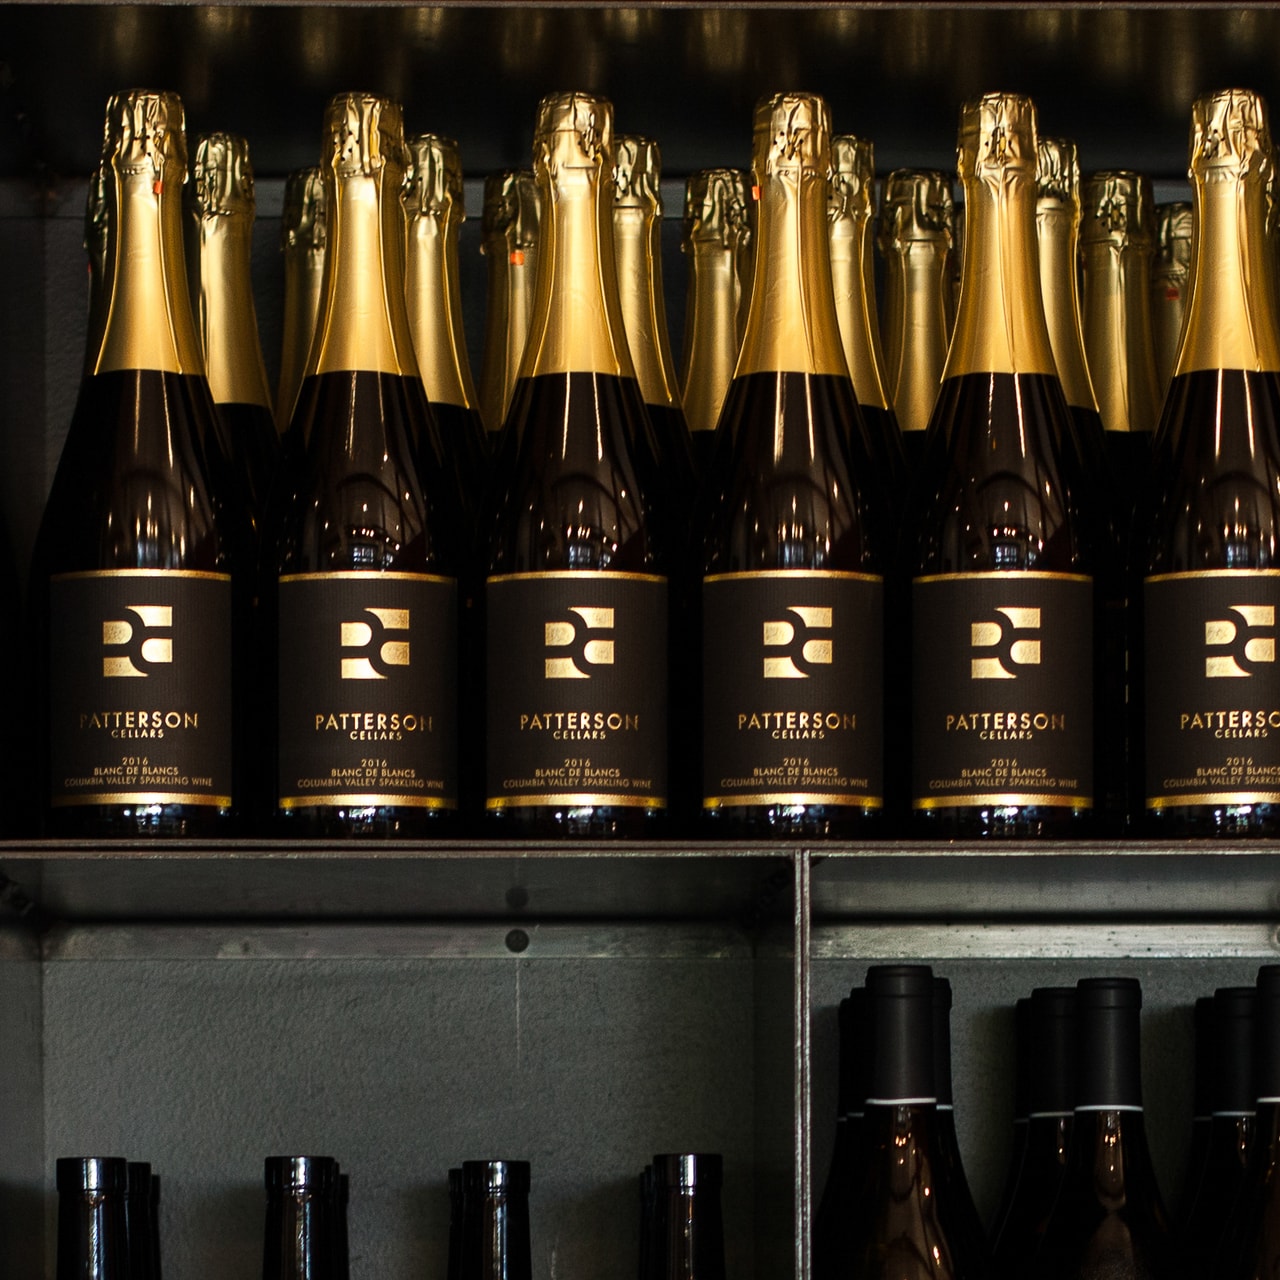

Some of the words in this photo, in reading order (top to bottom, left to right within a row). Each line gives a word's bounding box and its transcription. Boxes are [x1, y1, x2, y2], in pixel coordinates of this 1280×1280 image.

[79, 711, 199, 730] PATTERSON
[315, 713, 433, 731] PATTERSON
[520, 713, 638, 731] PATTERSON
[738, 713, 856, 730] PATTERSON
[946, 713, 1064, 730] PATTERSON
[111, 729, 164, 739] CELLARS
[349, 730, 403, 741] CELLARS
[554, 730, 606, 740] CELLARS
[772, 730, 825, 739] CELLARS
[980, 731, 1032, 739] CELLARS
[1215, 729, 1268, 738] CELLARS
[783, 758, 809, 766] 2016
[754, 768, 784, 776] BLANC
[787, 768, 800, 776] DE
[802, 768, 838, 776] BLANCS
[721, 779, 764, 787] COLUMBIA
[766, 778, 798, 786] VALLEY
[800, 777, 847, 786] SPARKLING
